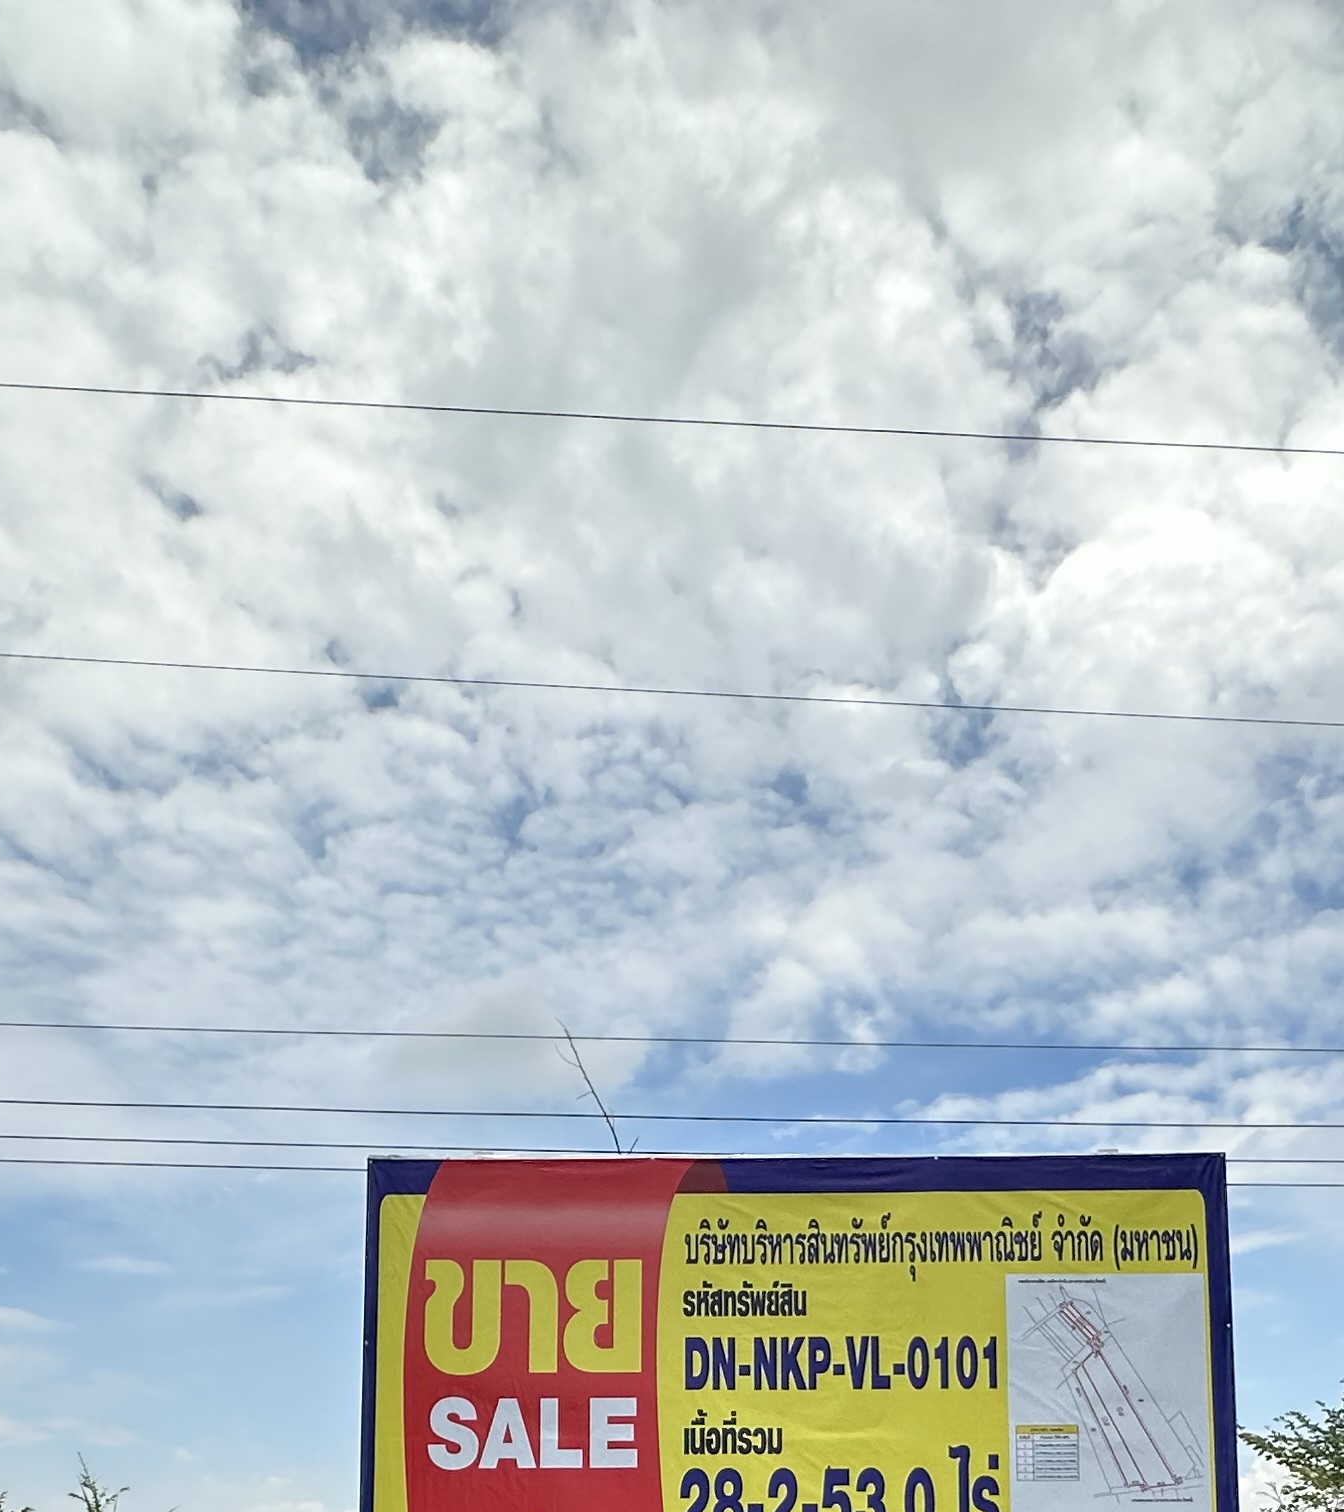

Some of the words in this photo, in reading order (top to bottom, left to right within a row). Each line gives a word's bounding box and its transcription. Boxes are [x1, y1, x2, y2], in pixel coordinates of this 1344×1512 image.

[684, 1211, 1043, 1282] บริษัทบริหารสินทรัพย์กรุงเทพพาณิชย์
[1051, 1214, 1104, 1261] จำกัด
[1113, 1224, 1199, 1270] (มหาชน)
[424, 1259, 643, 1376] ขาย
[682, 1280, 807, 1317] รหัสทรัพย์สิน
[684, 1335, 998, 1390] DN-NKP-VL-0101
[427, 1396, 638, 1471] SALE
[683, 1409, 783, 1455] เนื้อที่รวม
